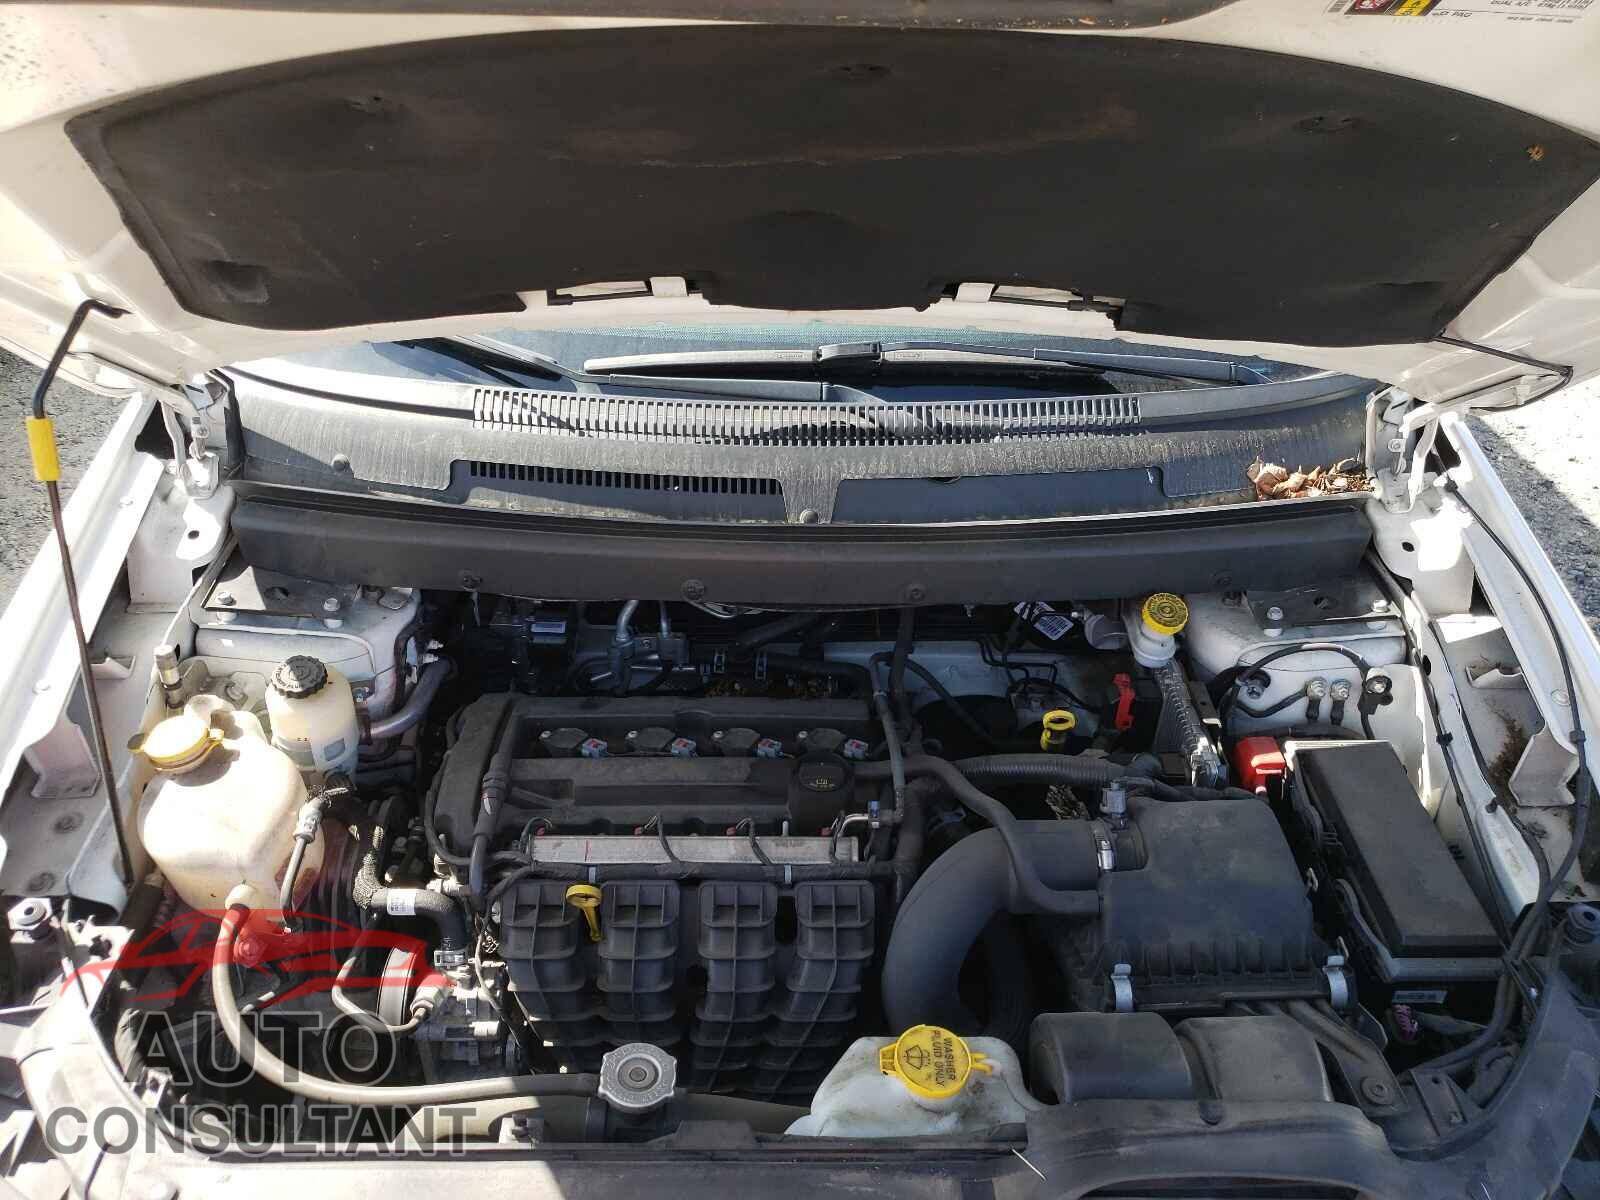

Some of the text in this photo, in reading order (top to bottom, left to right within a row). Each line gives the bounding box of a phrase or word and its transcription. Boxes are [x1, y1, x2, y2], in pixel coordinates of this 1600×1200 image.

[932, 1030, 945, 1087] FLUID ONLY
[943, 1037, 956, 1080] WASHER
